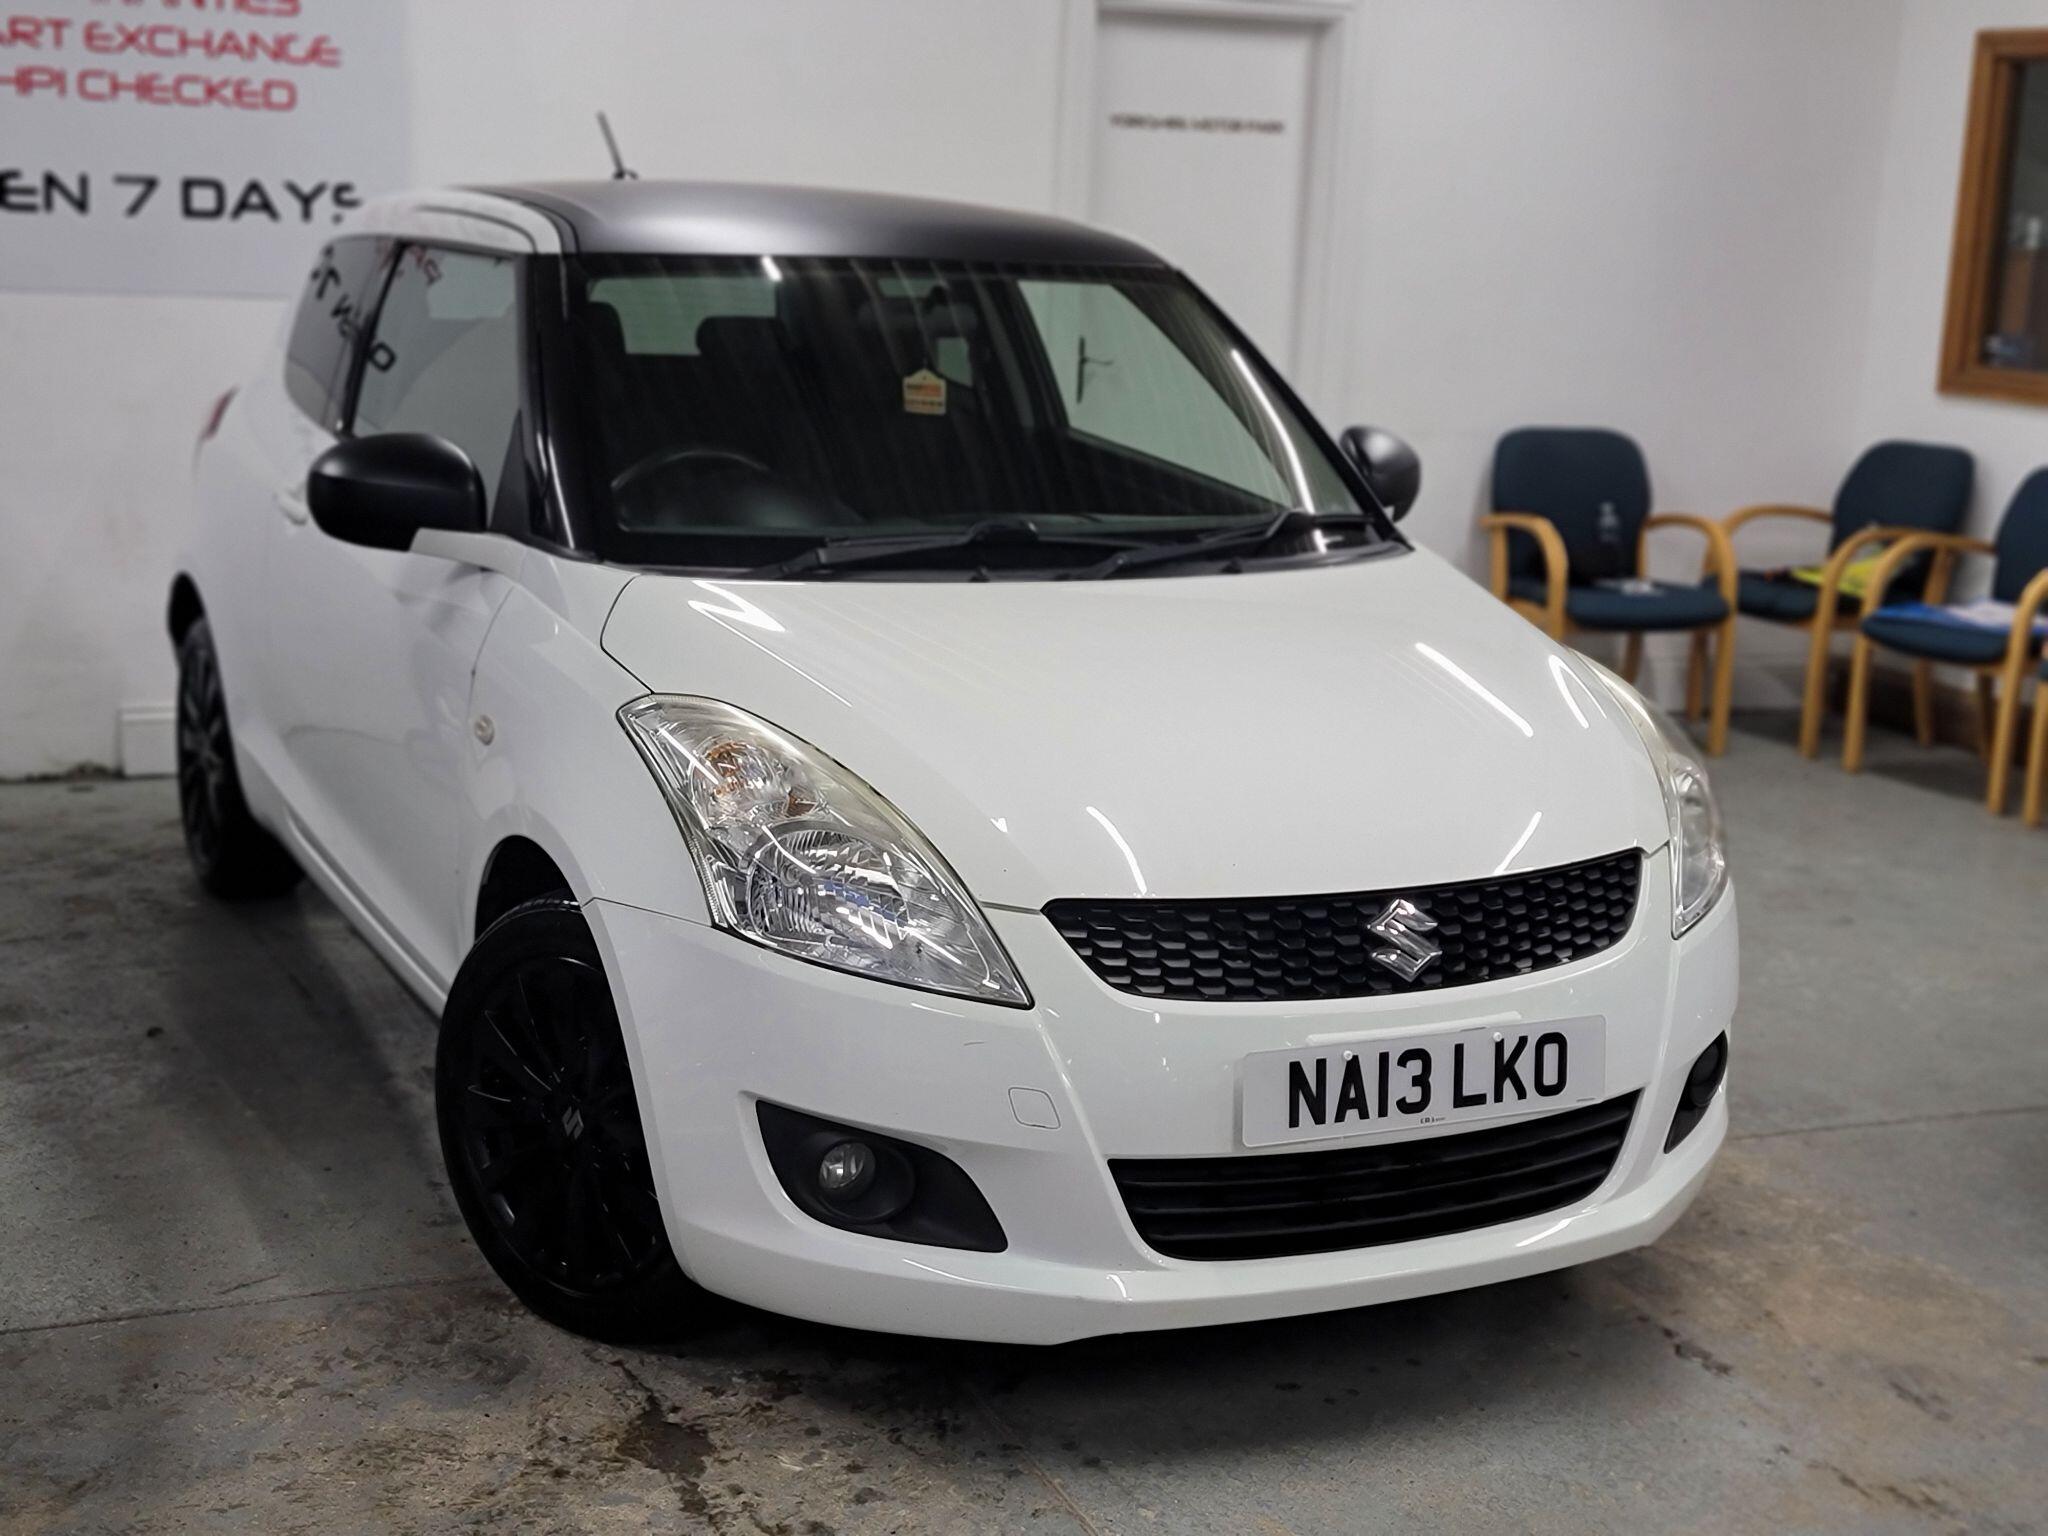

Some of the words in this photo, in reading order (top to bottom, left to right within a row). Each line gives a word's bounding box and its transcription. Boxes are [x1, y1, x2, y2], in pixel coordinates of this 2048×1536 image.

[84, 22, 342, 67] EXCHANGE
[77, 70, 298, 111] CHECKED
[113, 176, 159, 217] 7
[1289, 1047, 1432, 1128] NA13
[1453, 1031, 1568, 1108] LKO
